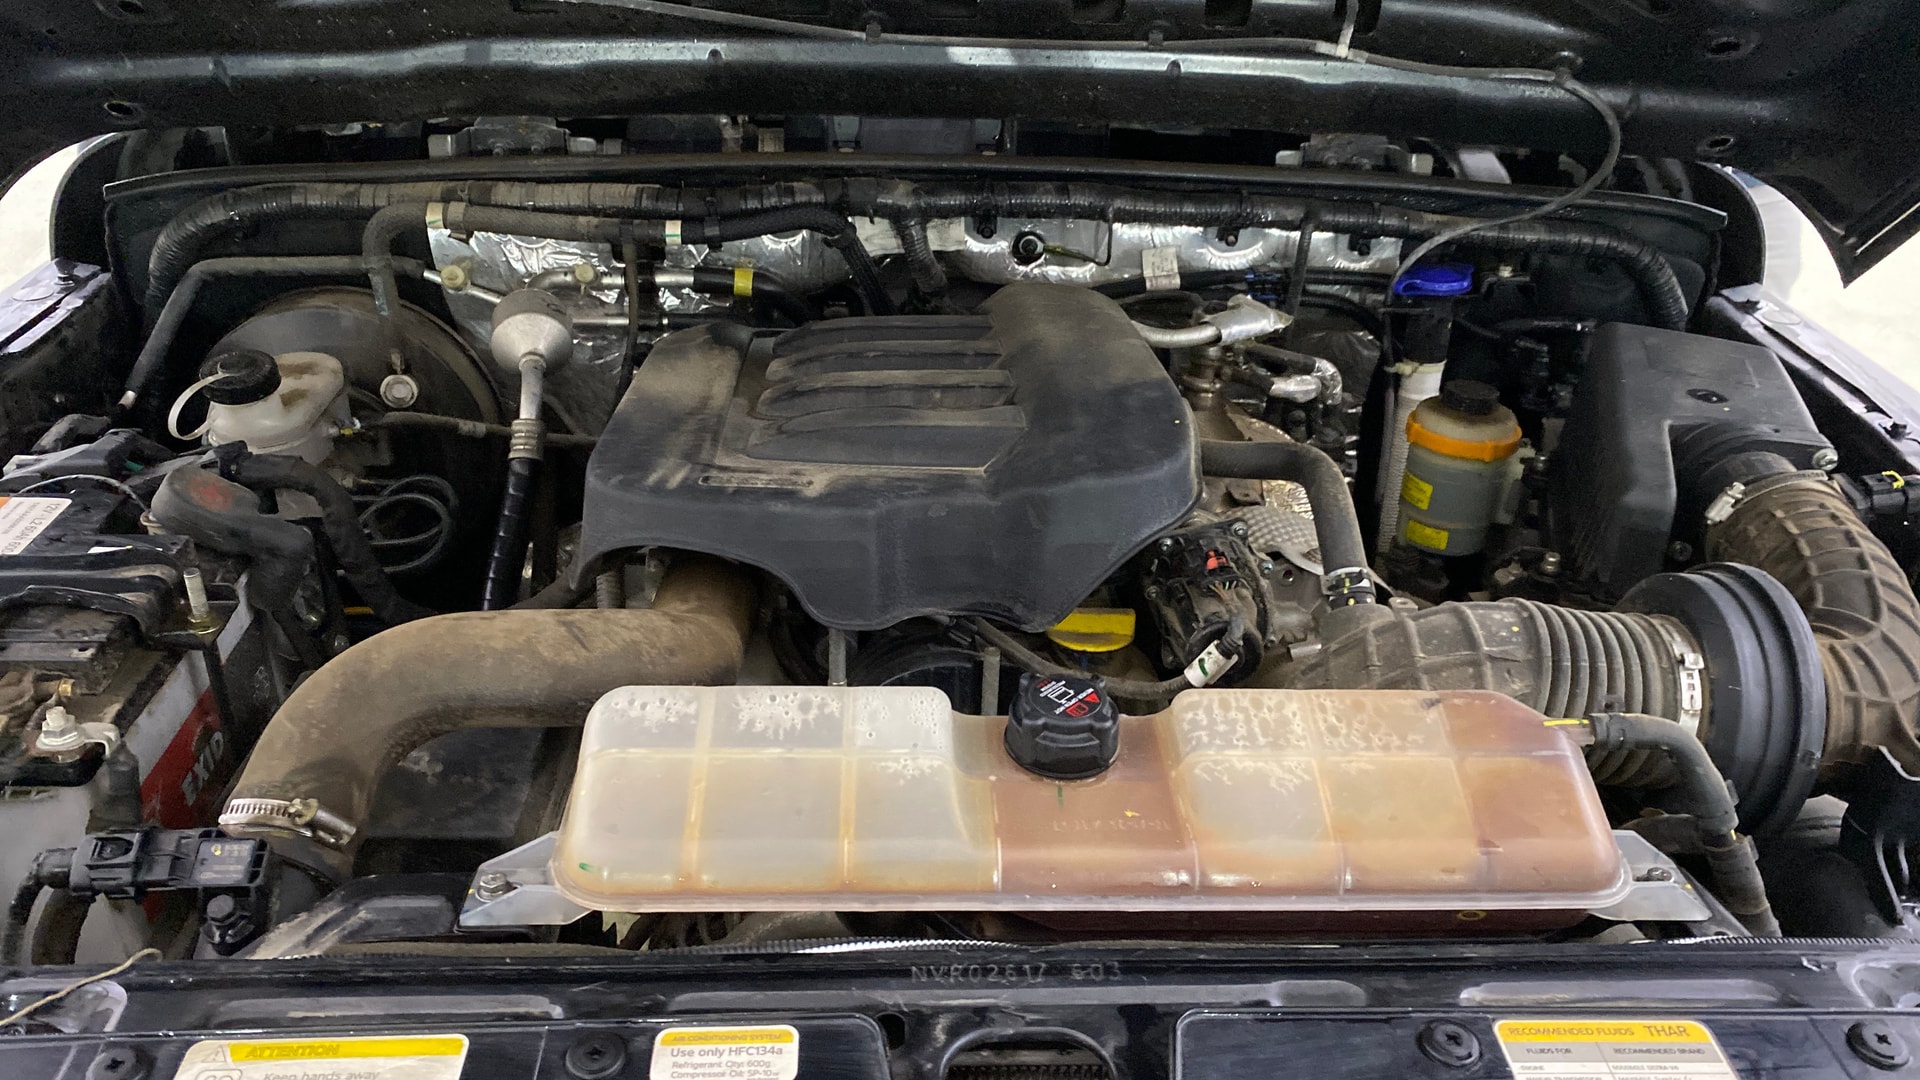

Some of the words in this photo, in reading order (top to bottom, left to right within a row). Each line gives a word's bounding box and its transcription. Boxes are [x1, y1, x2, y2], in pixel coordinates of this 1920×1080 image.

[1508, 1027, 1594, 1036] RECOMMENDED
[1596, 1027, 1635, 1036] FLUIDS
[1643, 1025, 1690, 1037] THAR
[687, 1033, 747, 1042] CONDITIONING
[749, 1033, 782, 1041] SYSTEM
[245, 1044, 340, 1059] ATTENTION
[671, 1047, 695, 1058] Use
[698, 1047, 726, 1059] only
[728, 1045, 784, 1057] HFC134a
[672, 1060, 722, 1070] Refrigerant
[301, 1071, 341, 1080] hands
[671, 1070, 726, 1080] Compressor
